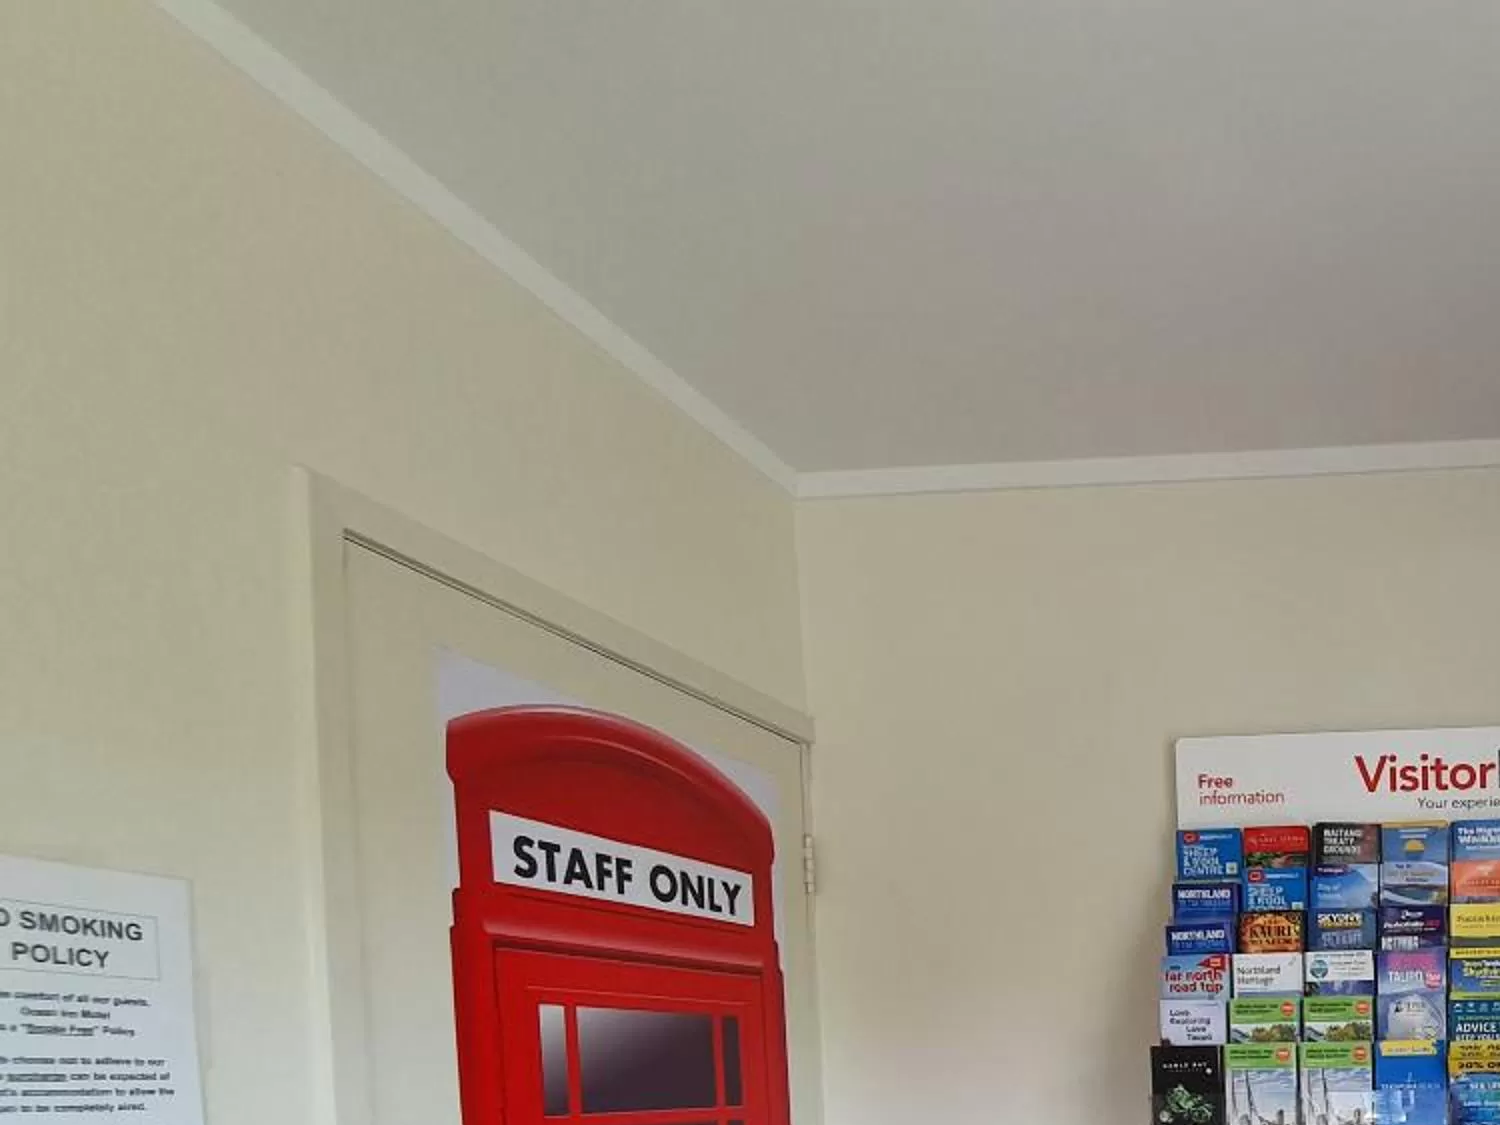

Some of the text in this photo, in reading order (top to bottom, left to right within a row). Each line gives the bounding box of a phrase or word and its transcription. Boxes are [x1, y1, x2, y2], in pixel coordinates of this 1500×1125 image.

[1198, 773, 1233, 789] Free
[1199, 789, 1285, 806] information
[1417, 797, 1447, 810] Your
[1183, 846, 1217, 857] SHEEP
[514, 835, 742, 917] STAFF ONLY
[1178, 889, 1232, 900] NORTHLAND
[1248, 886, 1284, 898] SHEEP
[19, 910, 144, 942] SMOKING
[1249, 925, 1293, 938] KAURI
[1171, 931, 1226, 942] NORTHLAND
[11, 941, 111, 969] POLICY
[1165, 970, 1223, 983] far north
[1237, 966, 1281, 977] Northland
[1169, 981, 1224, 995] road trip
[1455, 1023, 1495, 1035] ADVICE
